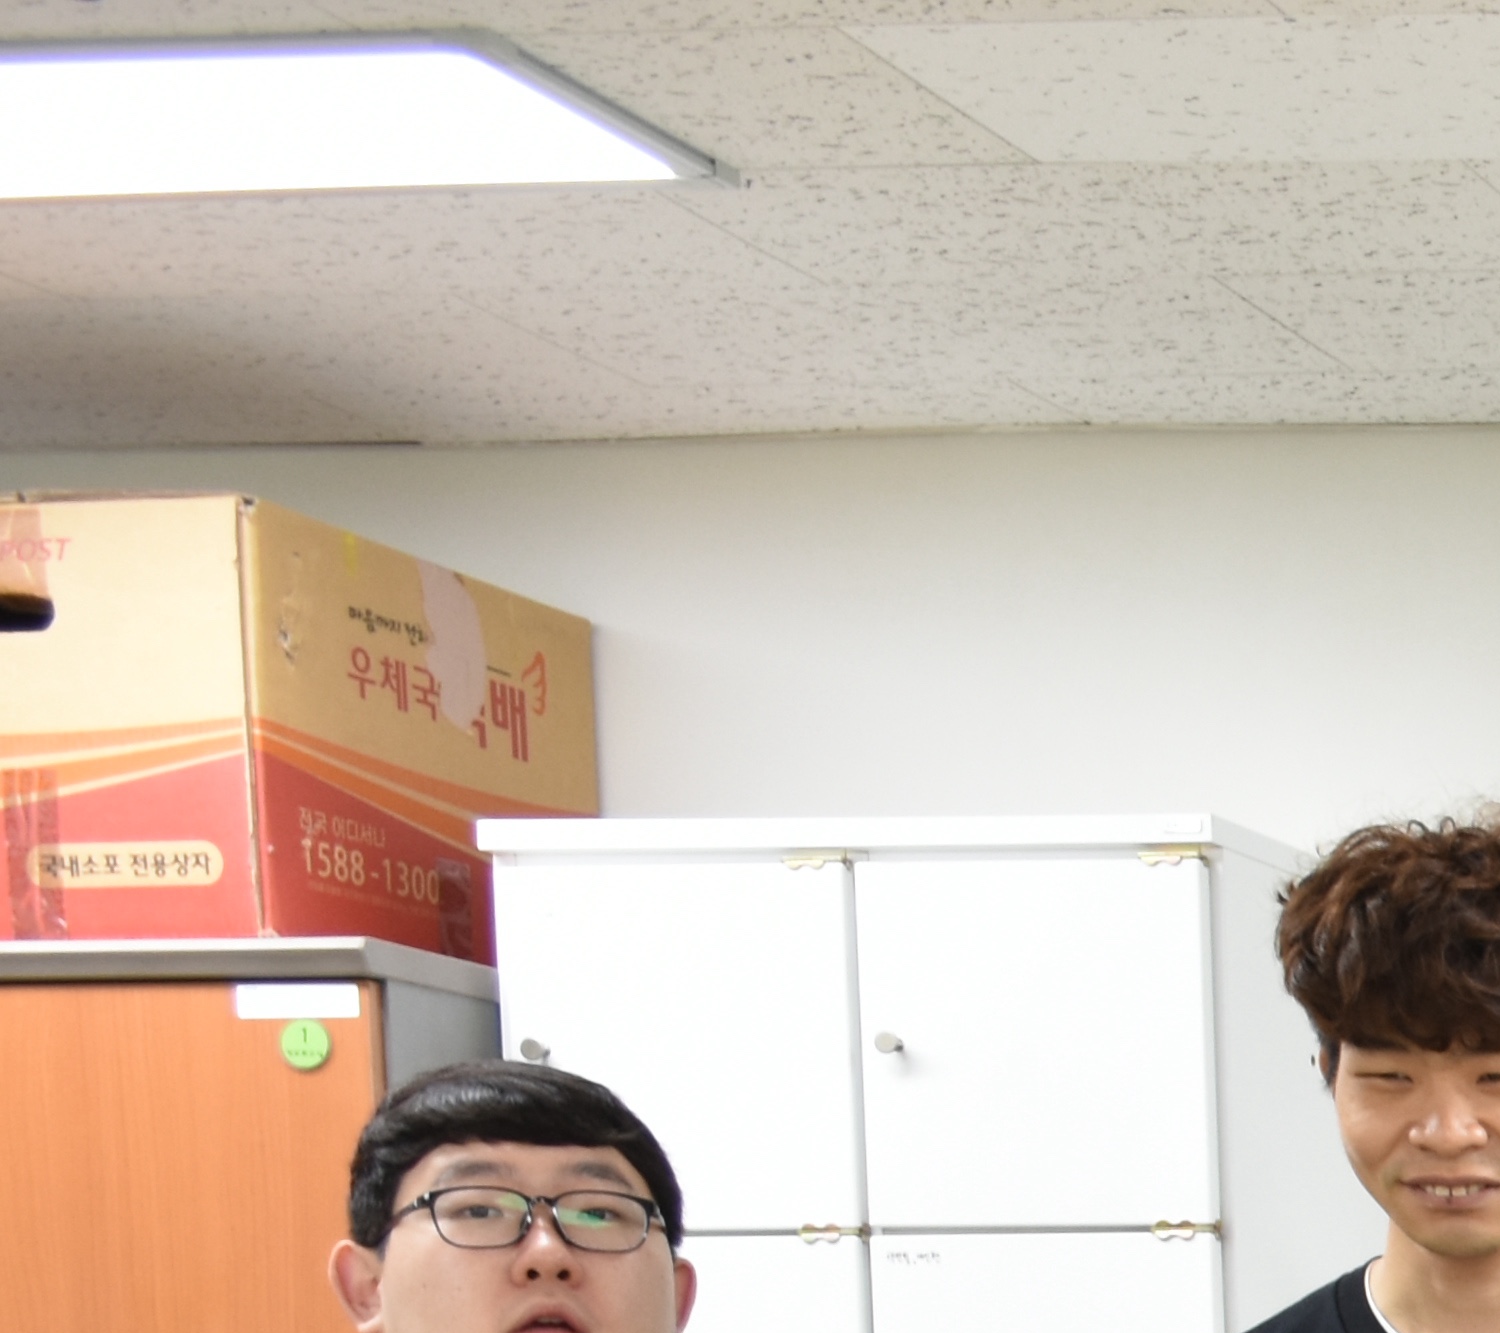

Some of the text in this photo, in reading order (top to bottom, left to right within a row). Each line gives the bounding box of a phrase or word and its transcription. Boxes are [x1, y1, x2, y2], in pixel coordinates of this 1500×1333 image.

[40, 852, 211, 878] 국내소포 전용상자
[301, 837, 440, 905] 1588-1300
